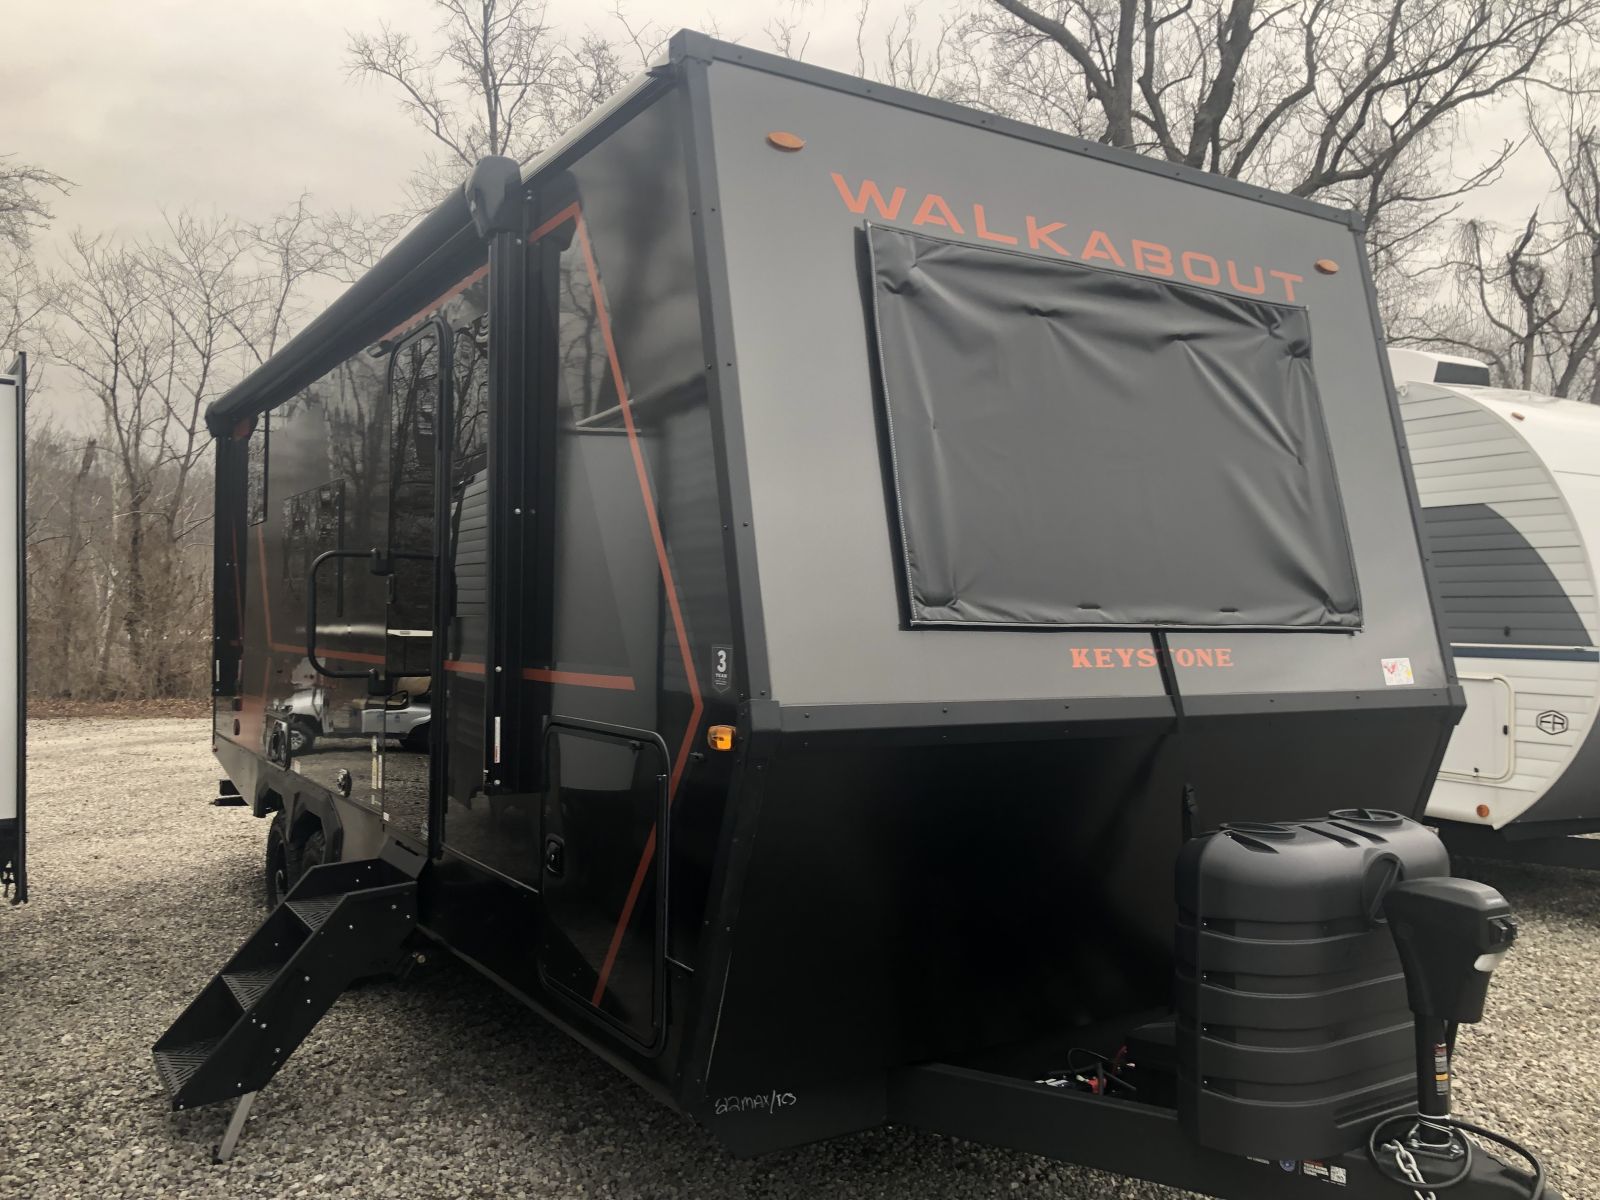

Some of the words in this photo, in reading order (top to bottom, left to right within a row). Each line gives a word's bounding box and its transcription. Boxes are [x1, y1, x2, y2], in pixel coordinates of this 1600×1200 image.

[831, 172, 1303, 302] WALKABOUT
[717, 650, 727, 673] 3
[1070, 648, 1233, 669] KEYSONE
